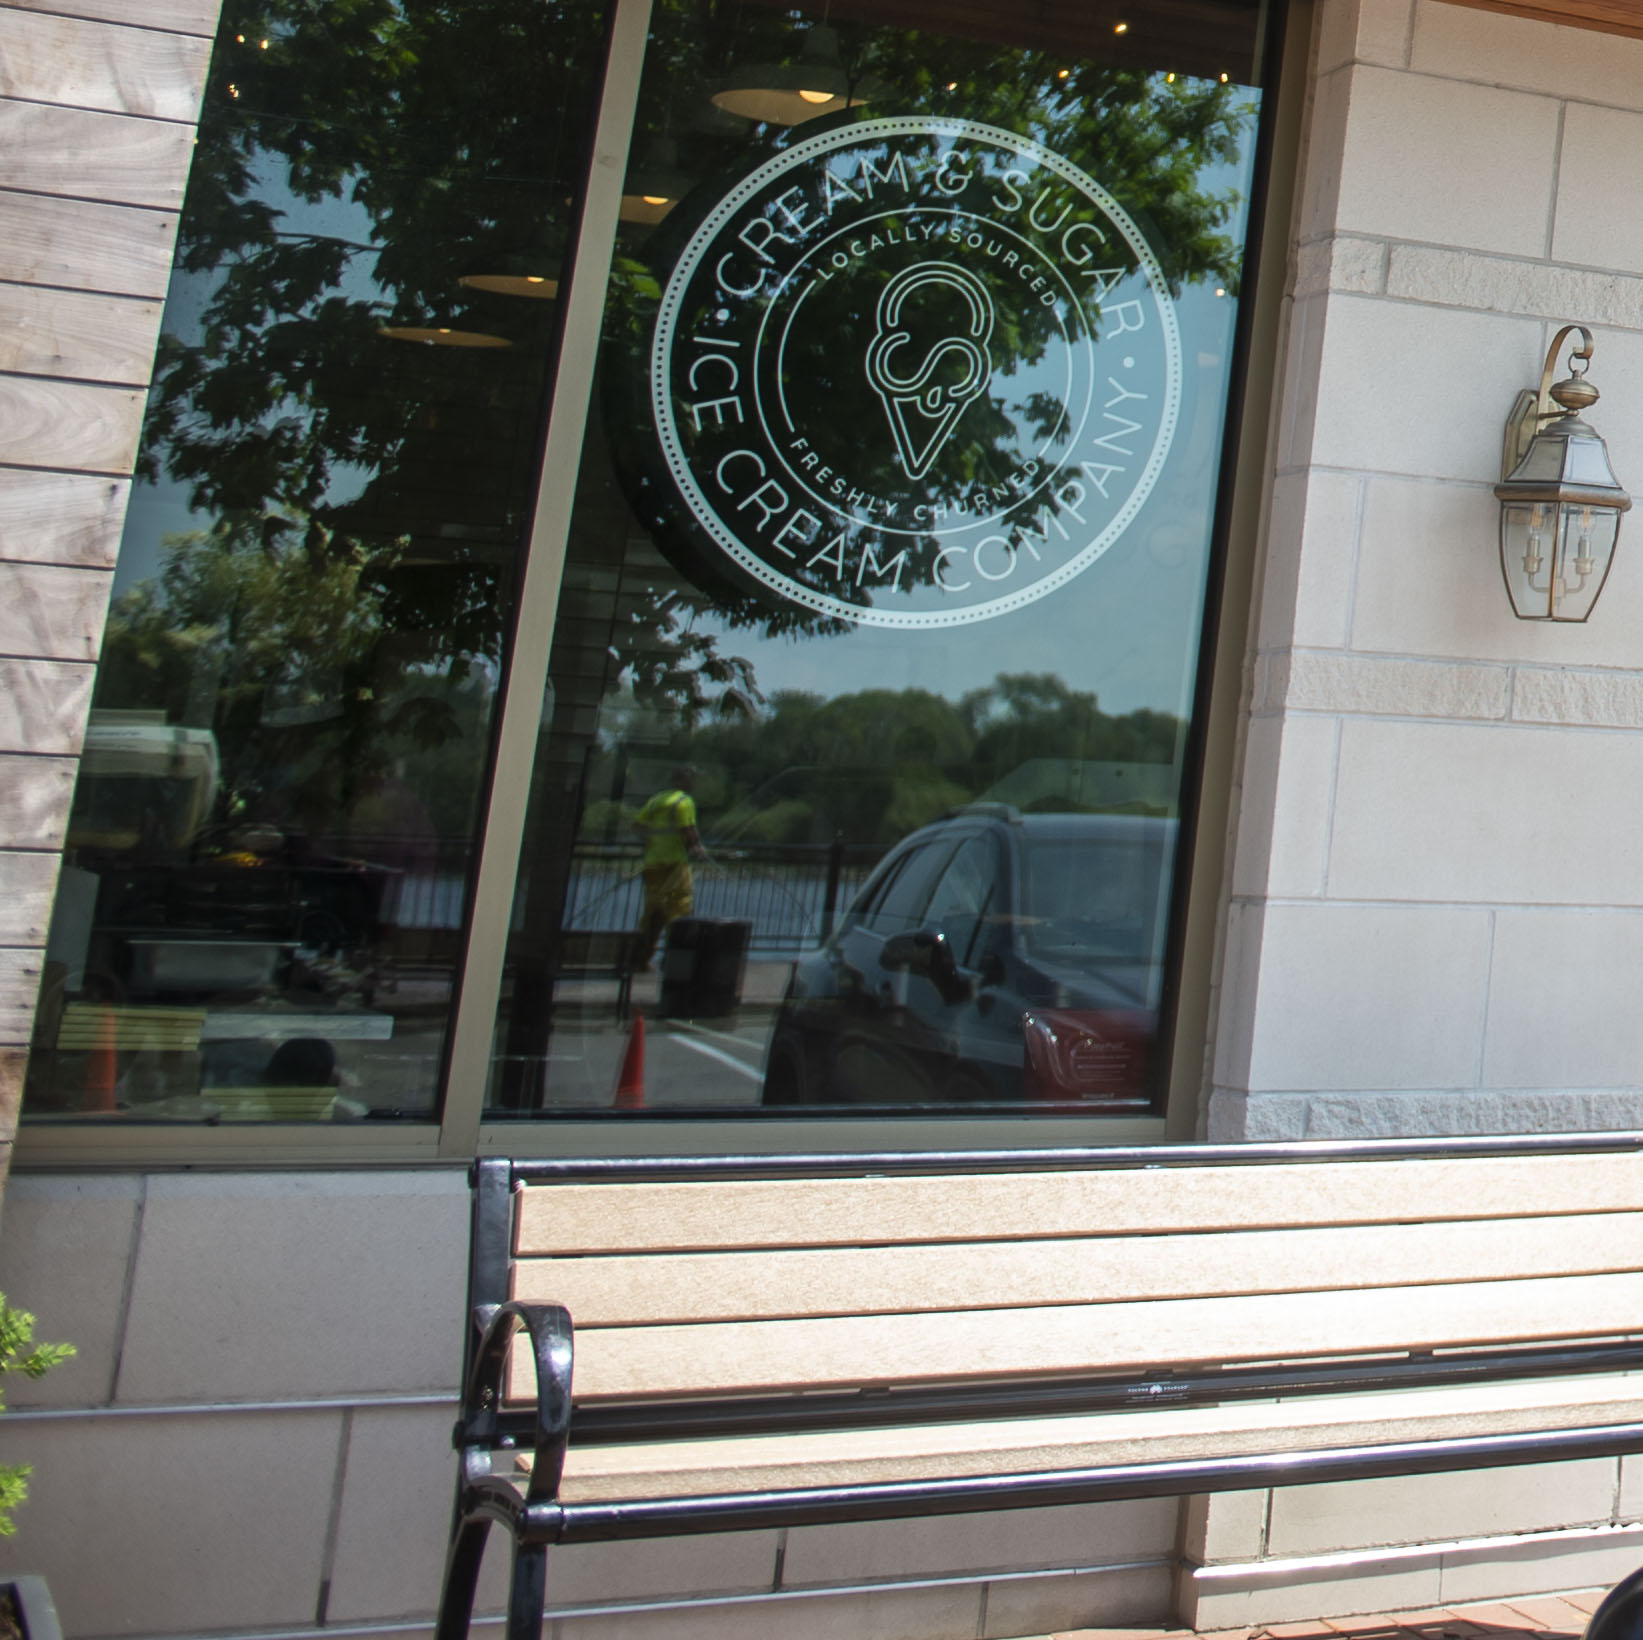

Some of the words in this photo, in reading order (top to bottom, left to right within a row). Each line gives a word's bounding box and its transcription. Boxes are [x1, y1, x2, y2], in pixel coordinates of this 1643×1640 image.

[716, 151, 910, 298] CREAM
[935, 150, 972, 195] &
[992, 169, 1146, 340] SUGAR
[817, 223, 935, 281] LOCALLY
[950, 228, 1057, 308] SOURCED
[689, 336, 744, 431] ICE
[716, 449, 906, 593] CREAM
[790, 436, 898, 517] FRESHLY
[913, 459, 1040, 523] CHURNED
[932, 376, 1149, 592] COMPANY
